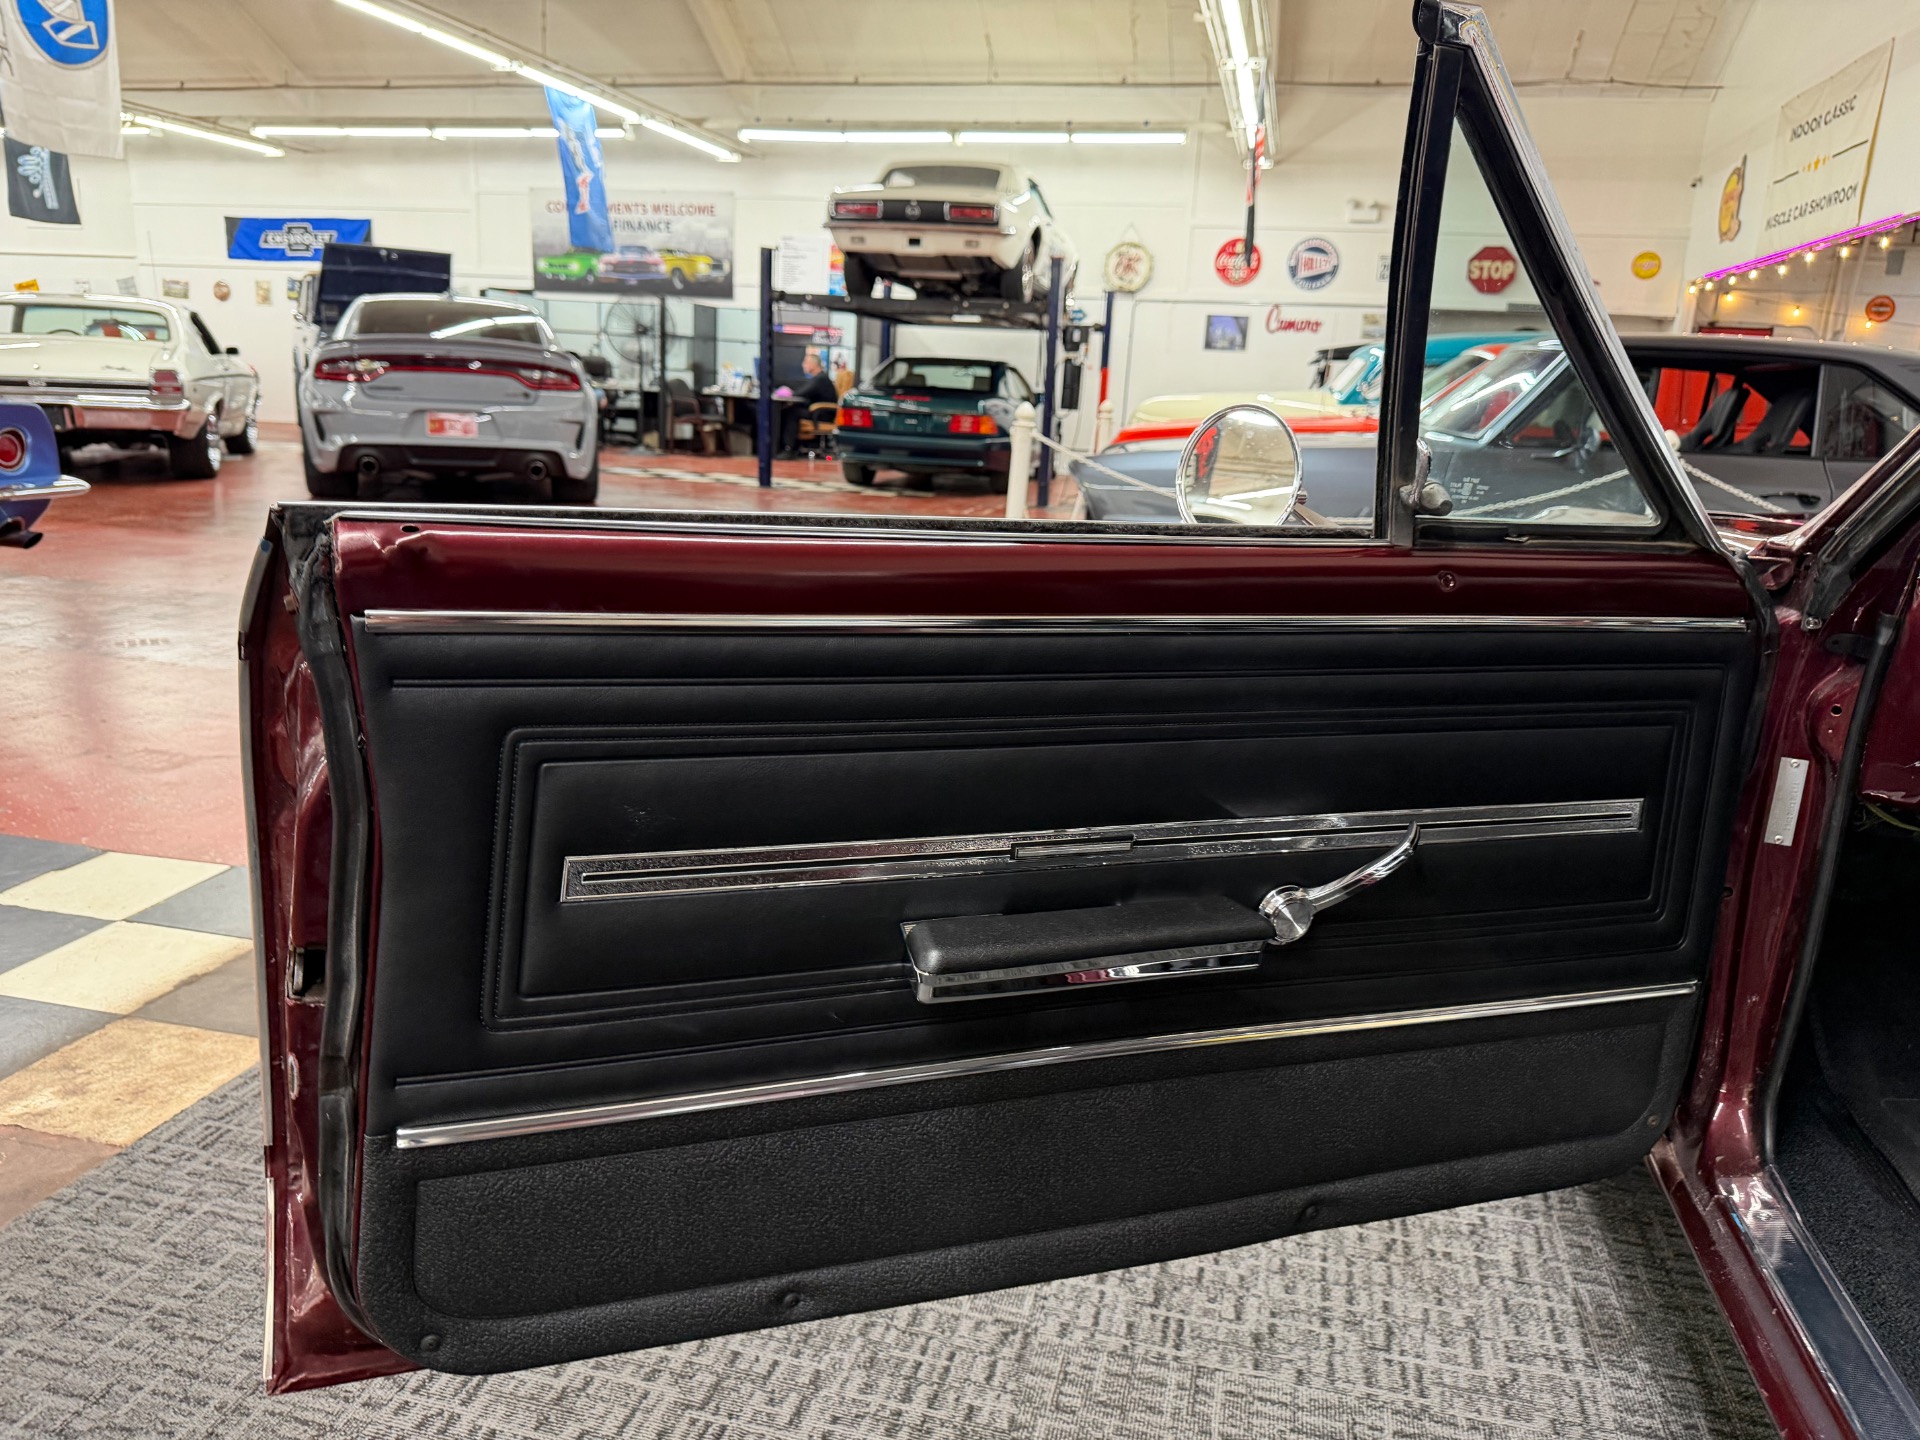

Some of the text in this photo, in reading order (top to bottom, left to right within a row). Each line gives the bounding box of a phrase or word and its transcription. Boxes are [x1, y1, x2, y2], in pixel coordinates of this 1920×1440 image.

[652, 203, 716, 217] WELCOME
[613, 219, 672, 234] FINANCE
[1469, 259, 1515, 281] STOP
[1265, 303, 1322, 333] Camaro
